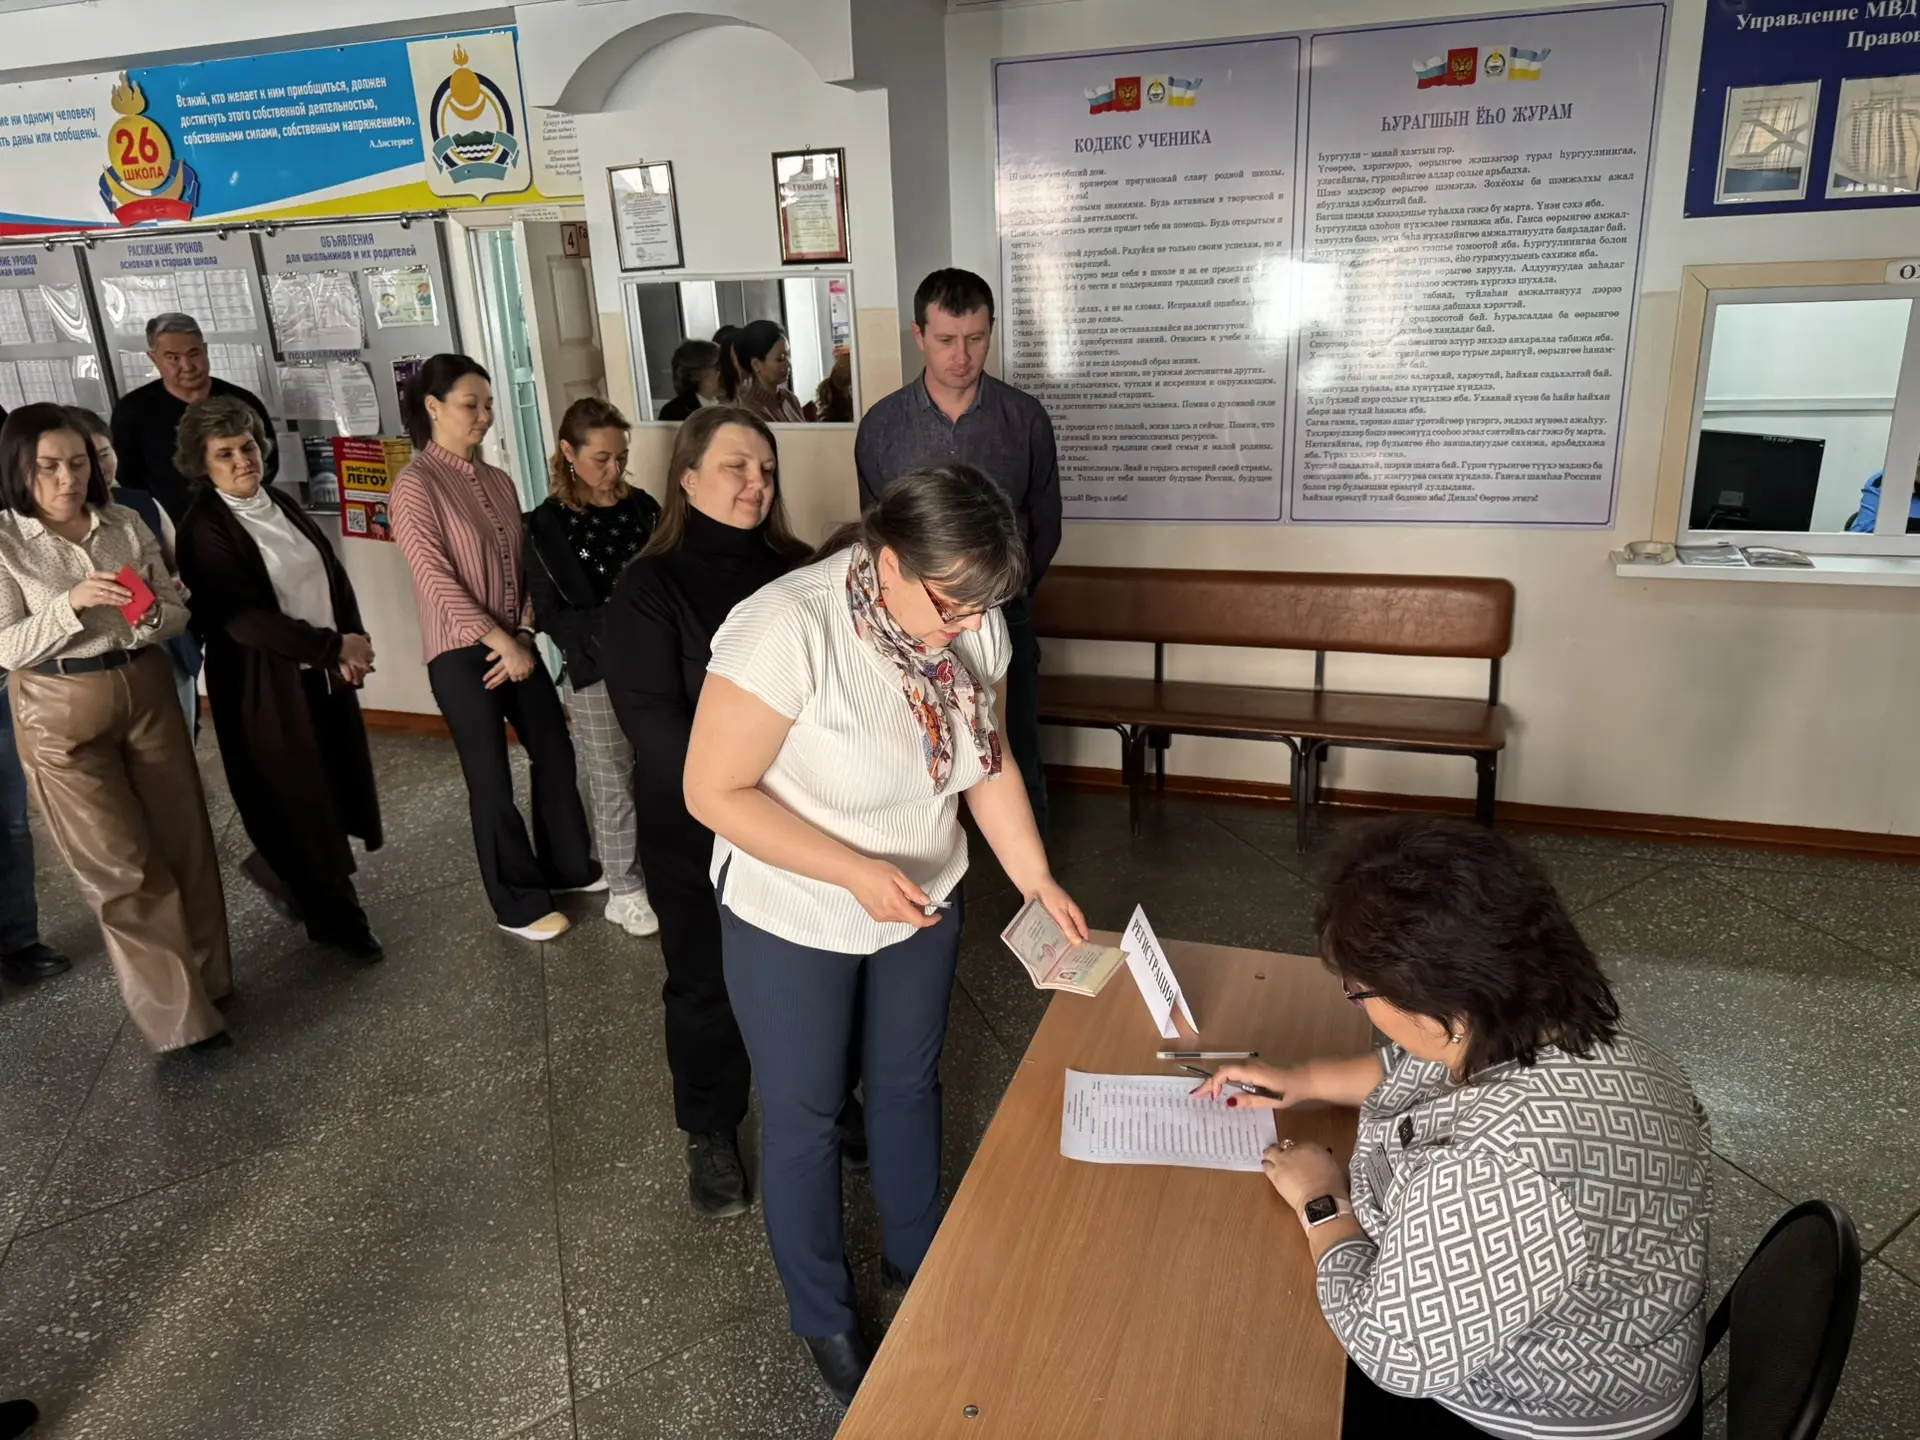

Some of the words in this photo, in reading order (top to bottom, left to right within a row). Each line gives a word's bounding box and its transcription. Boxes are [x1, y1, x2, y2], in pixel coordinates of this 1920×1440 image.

[1736, 7, 1859, 32] Управление
[1864, 0, 1918, 19] МВД
[176, 93, 210, 108] Всякий,
[211, 93, 225, 104] кто
[227, 90, 258, 103] желает
[259, 90, 266, 100] к
[267, 87, 285, 100] ним
[287, 80, 349, 100] приобщиться,
[351, 76, 387, 93] должен
[11, 115, 22, 126] ни
[23, 111, 54, 126] одному
[55, 107, 96, 121] человеку
[180, 111, 226, 130] достигнуть
[228, 109, 251, 122] этого
[252, 103, 306, 121] собственной
[308, 97, 378, 116] деятельностью,
[1380, 108, 1469, 132] ҺУРАГШЫН
[1475, 104, 1506, 125] ЁҺО
[1512, 102, 1573, 124] ЖУРАМ
[12, 134, 34, 148] даны
[36, 132, 52, 144] или
[54, 127, 101, 142] сообщены.
[183, 129, 243, 146] собственными
[245, 127, 281, 140] силами,
[282, 120, 340, 138] собственным
[342, 115, 415, 135] напряжением».
[115, 126, 159, 166] 26
[1074, 134, 1132, 155] КОДЕКС
[1137, 128, 1212, 149] УЧЕНИКА
[1371, 147, 1398, 157] манай
[1400, 147, 1435, 155] хамтын
[1437, 146, 1455, 156] гэр.
[123, 166, 165, 181] ШКОЛА
[1061, 167, 1087, 178] общий
[1089, 168, 1106, 176] дом.
[1079, 178, 1118, 189] примером
[1125, 173, 1176, 186] приумножай
[1184, 173, 1207, 183] славу
[1214, 169, 1243, 181] родной
[1251, 169, 1284, 178] школы,
[1427, 170, 1454, 180] алдар
[1485, 164, 1530, 177] арьбадха.
[1483, 177, 1524, 187] Зохёохы
[1530, 176, 1541, 185] ба
[1608, 173, 1634, 181] ажал
[1104, 200, 1146, 209] знаниями.
[1150, 197, 1169, 208] Будь
[1172, 196, 1214, 205] активным
[1227, 191, 1273, 204] творческой
[1407, 195, 1426, 204] бай.
[1502, 203, 1533, 213] марта.
[1584, 197, 1605, 207] яба.
[1082, 212, 1138, 222] деятельности.
[1516, 213, 1546, 223] Ганса
[1087, 225, 1111, 234] всегда
[1114, 224, 1140, 234] придет
[1143, 221, 1159, 230] тебе
[1173, 220, 1207, 229] помощь.
[1210, 217, 1229, 229] Будь
[1231, 217, 1274, 228] открытым
[1555, 223, 1605, 235] баярладаг
[1606, 222, 1626, 231] бай.
[320, 233, 374, 248] ОБЪЯВЛЕНИЯ
[567, 231, 574, 249] 4
[1456, 239, 1498, 250] томоотой
[1599, 234, 1627, 244] болон
[127, 242, 174, 256] РАСПИСАНИЕ
[175, 240, 203, 254] УРОКОВ
[286, 253, 301, 264] для
[302, 251, 351, 263] школьников
[353, 249, 359, 259] и
[361, 248, 371, 258] их
[372, 244, 417, 263] родителей
[1083, 245, 1119, 258] дружбой.
[1122, 244, 1155, 256] Радуйся
[1224, 241, 1260, 251] успехам,
[12, 254, 37, 266] УРОКОВ
[120, 258, 153, 269] основная
[154, 258, 160, 267] и
[162, 256, 192, 268] старшая
[193, 254, 218, 266] школа
[14, 266, 35, 276] школа
[1101, 271, 1117, 279] веди
[1121, 268, 1138, 277] себя
[1475, 265, 1516, 275] харуула.
[1119, 280, 1172, 290] поддержании
[1176, 275, 1214, 288] традиций
[1216, 274, 1239, 284] своей
[1167, 299, 1211, 311] Исправляй
[1119, 322, 1181, 333] останавливайся
[1194, 322, 1247, 332] достигнутом.
[1170, 332, 1207, 342] Относись
[1218, 331, 1240, 342] учебе
[1233, 367, 1265, 376] других.
[1162, 379, 1205, 388] искренним
[1217, 398, 1254, 409] духовной
[345, 466, 386, 474] ВЫСТАВКА
[347, 472, 388, 487] ЛЕГОУ
[1131, 918, 1174, 1007] РЕГИСТРАЦИЯ
